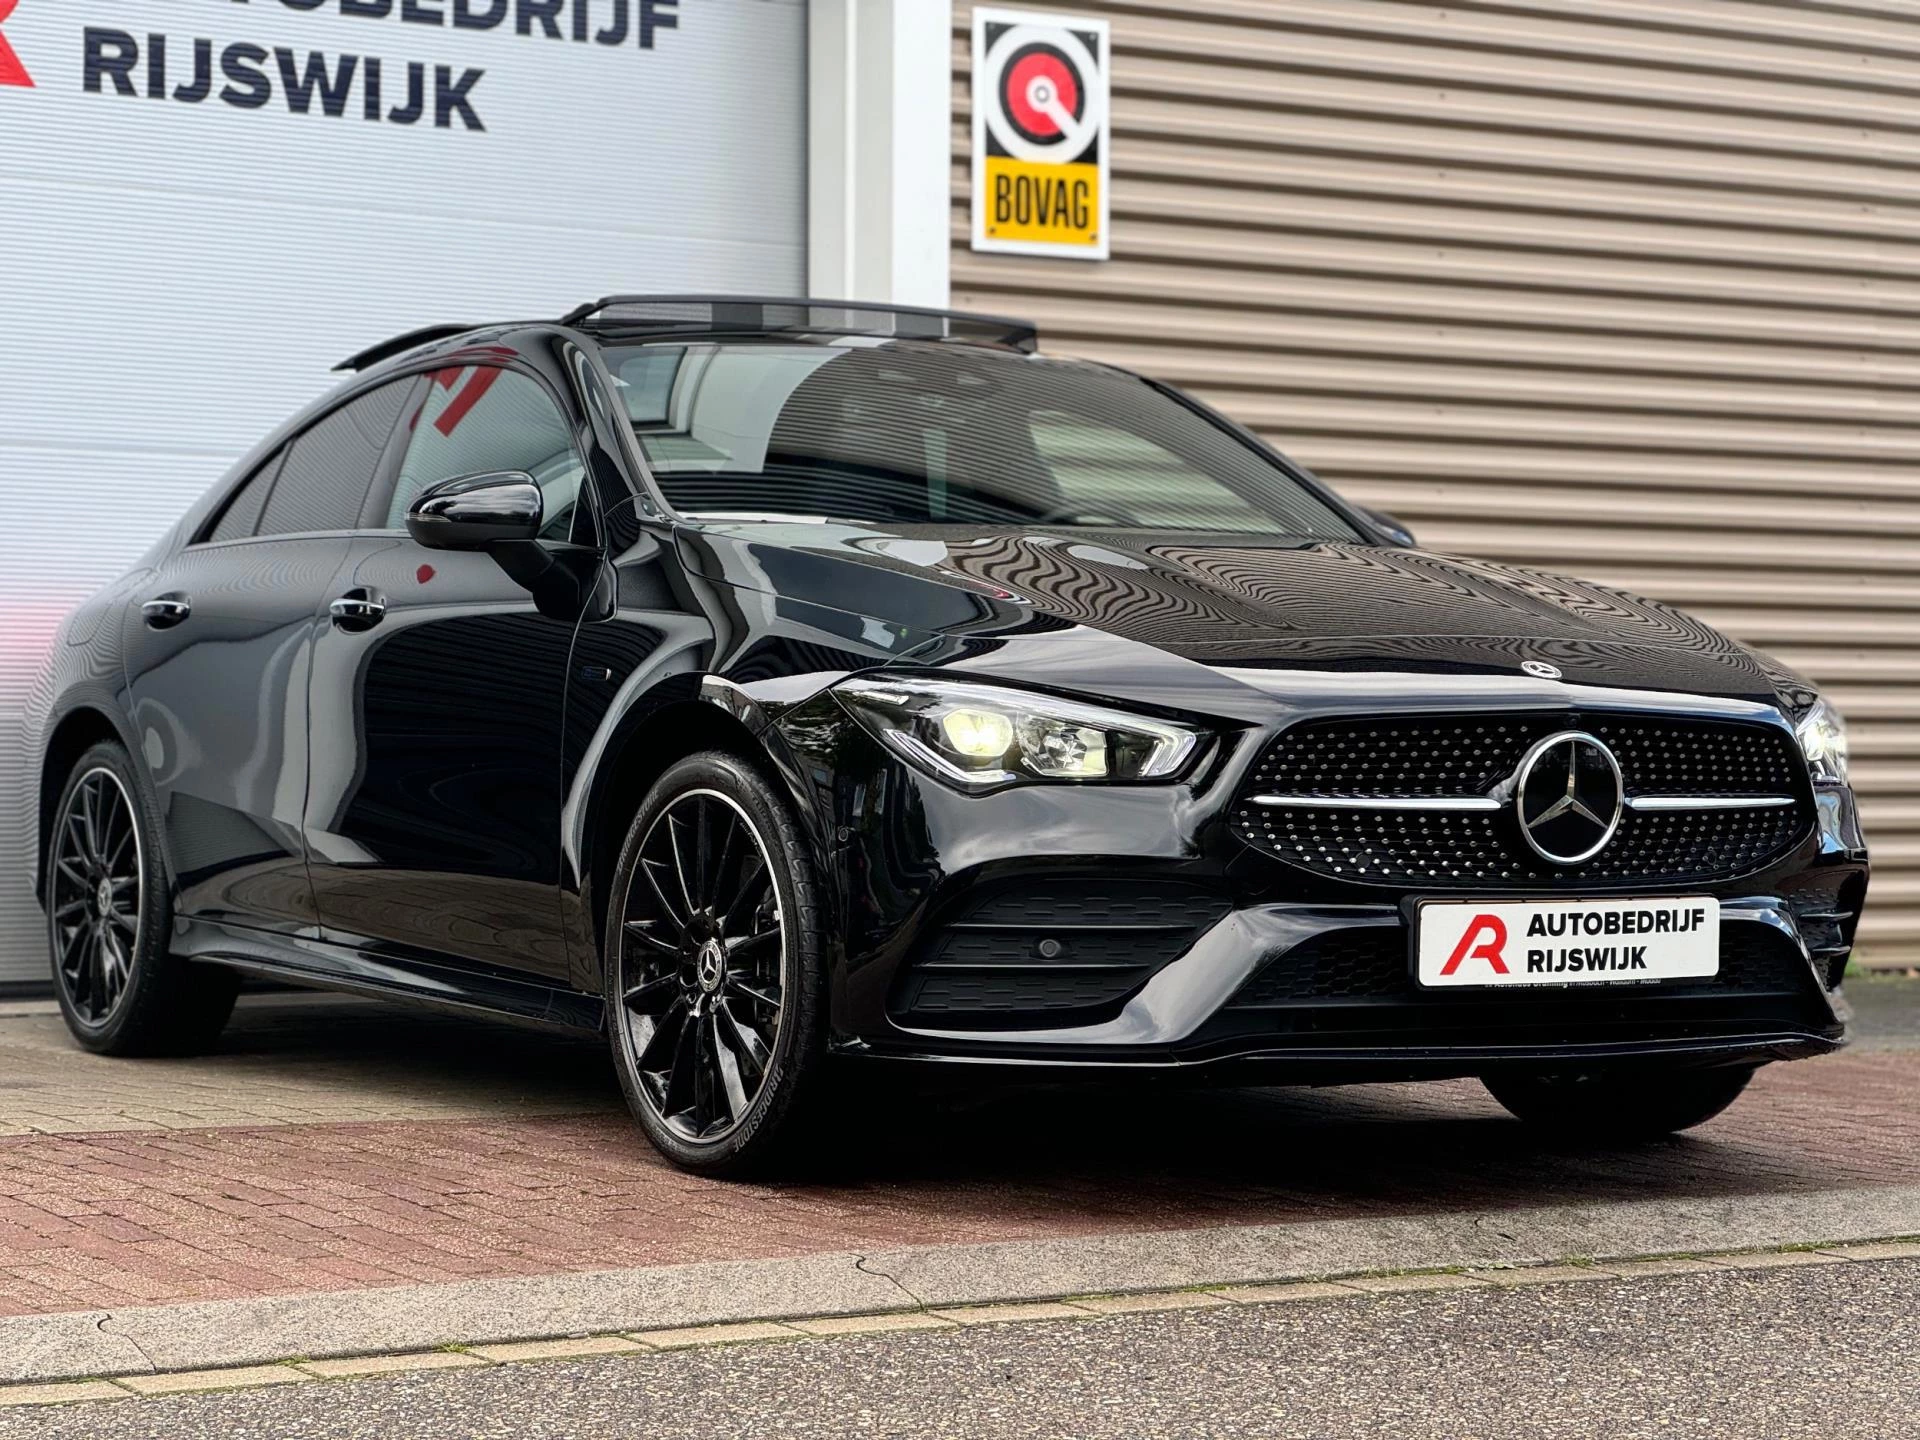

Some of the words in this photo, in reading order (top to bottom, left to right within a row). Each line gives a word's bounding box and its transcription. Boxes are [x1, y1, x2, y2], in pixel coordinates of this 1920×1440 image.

[83, 26, 487, 132] RIJSWIJK
[996, 174, 1088, 230] BOVAG
[1526, 908, 1705, 937] AUTOBEDRIJF
[1527, 946, 1648, 973] RIJSWIJK
[733, 1062, 784, 1153] BRIDGESTONE
